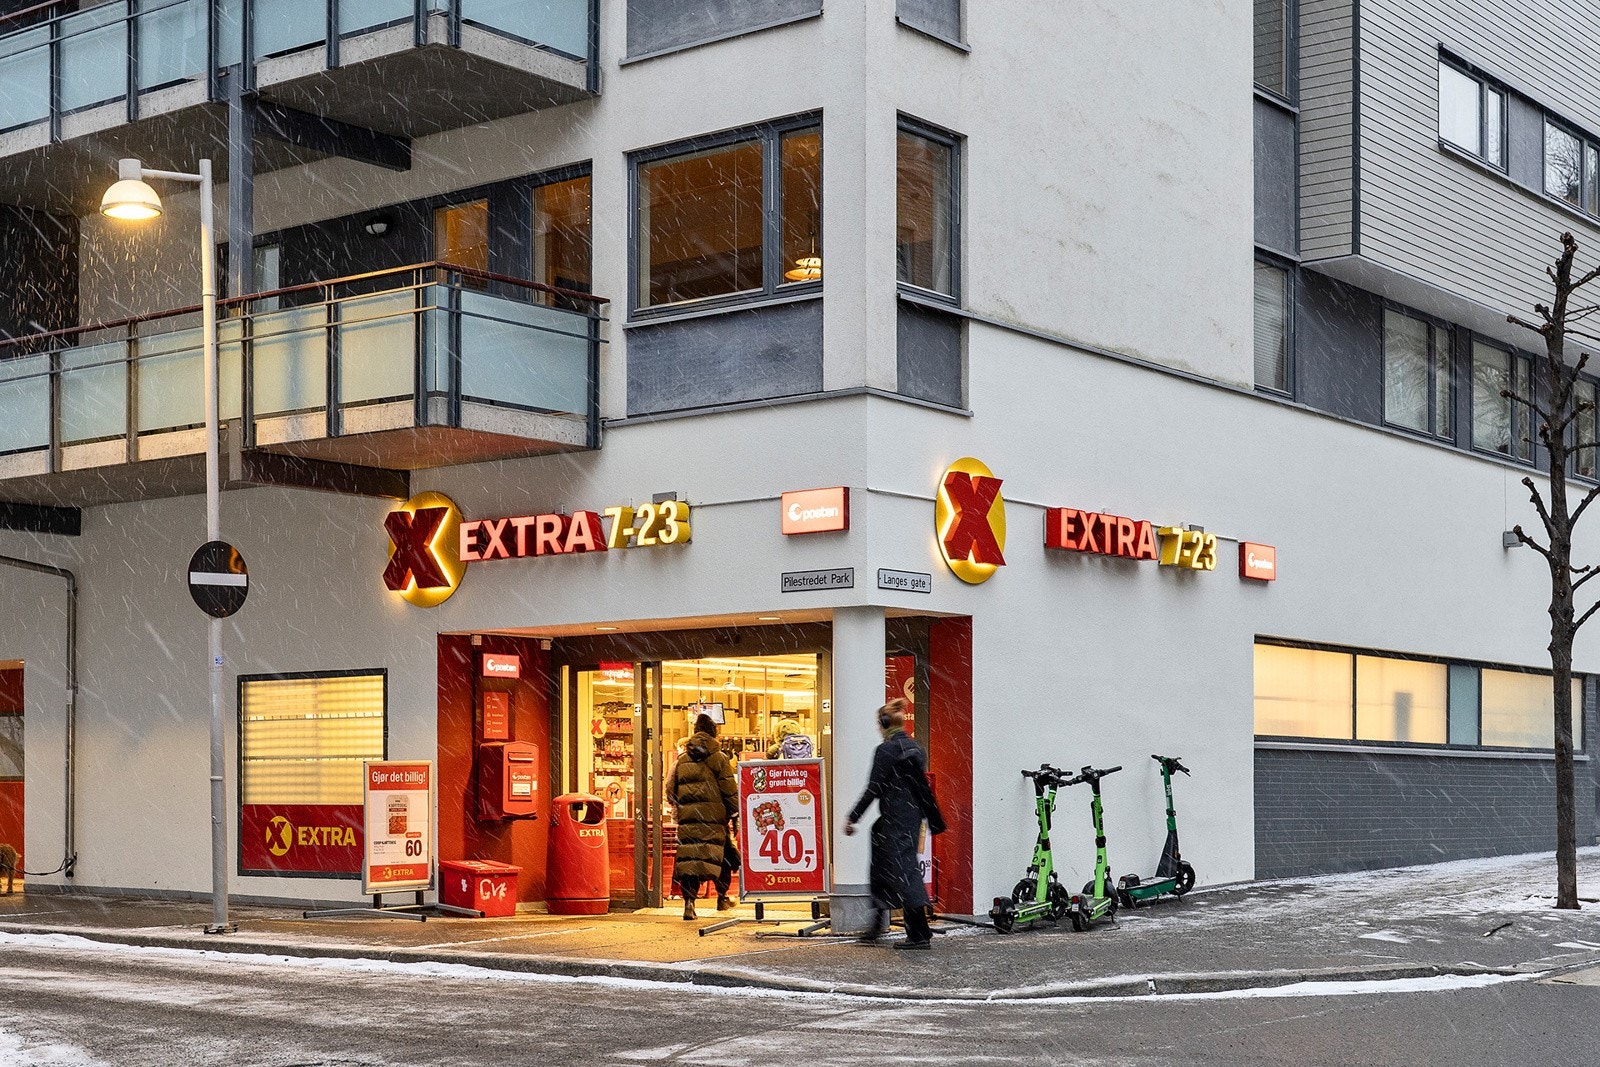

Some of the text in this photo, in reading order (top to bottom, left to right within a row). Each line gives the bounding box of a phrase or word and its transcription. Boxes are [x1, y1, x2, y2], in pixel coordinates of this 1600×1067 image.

[802, 506, 839, 522] posten
[943, 471, 1218, 571] X EXTRA 7-23
[383, 500, 688, 591] X EXTRA 7-23
[784, 573, 850, 588] Pilestredet Park
[883, 574, 926, 589] Langes gate
[495, 663, 517, 672] posten
[372, 771, 426, 785] Gjør det billig!
[769, 769, 783, 779] Gjør
[783, 769, 799, 777] frukt
[799, 770, 808, 778] og
[769, 778, 806, 788] grønt billig!
[298, 826, 357, 846] EXTRA
[579, 829, 605, 837] EXTRA
[405, 839, 422, 857] 60
[759, 829, 814, 868] 40,-
